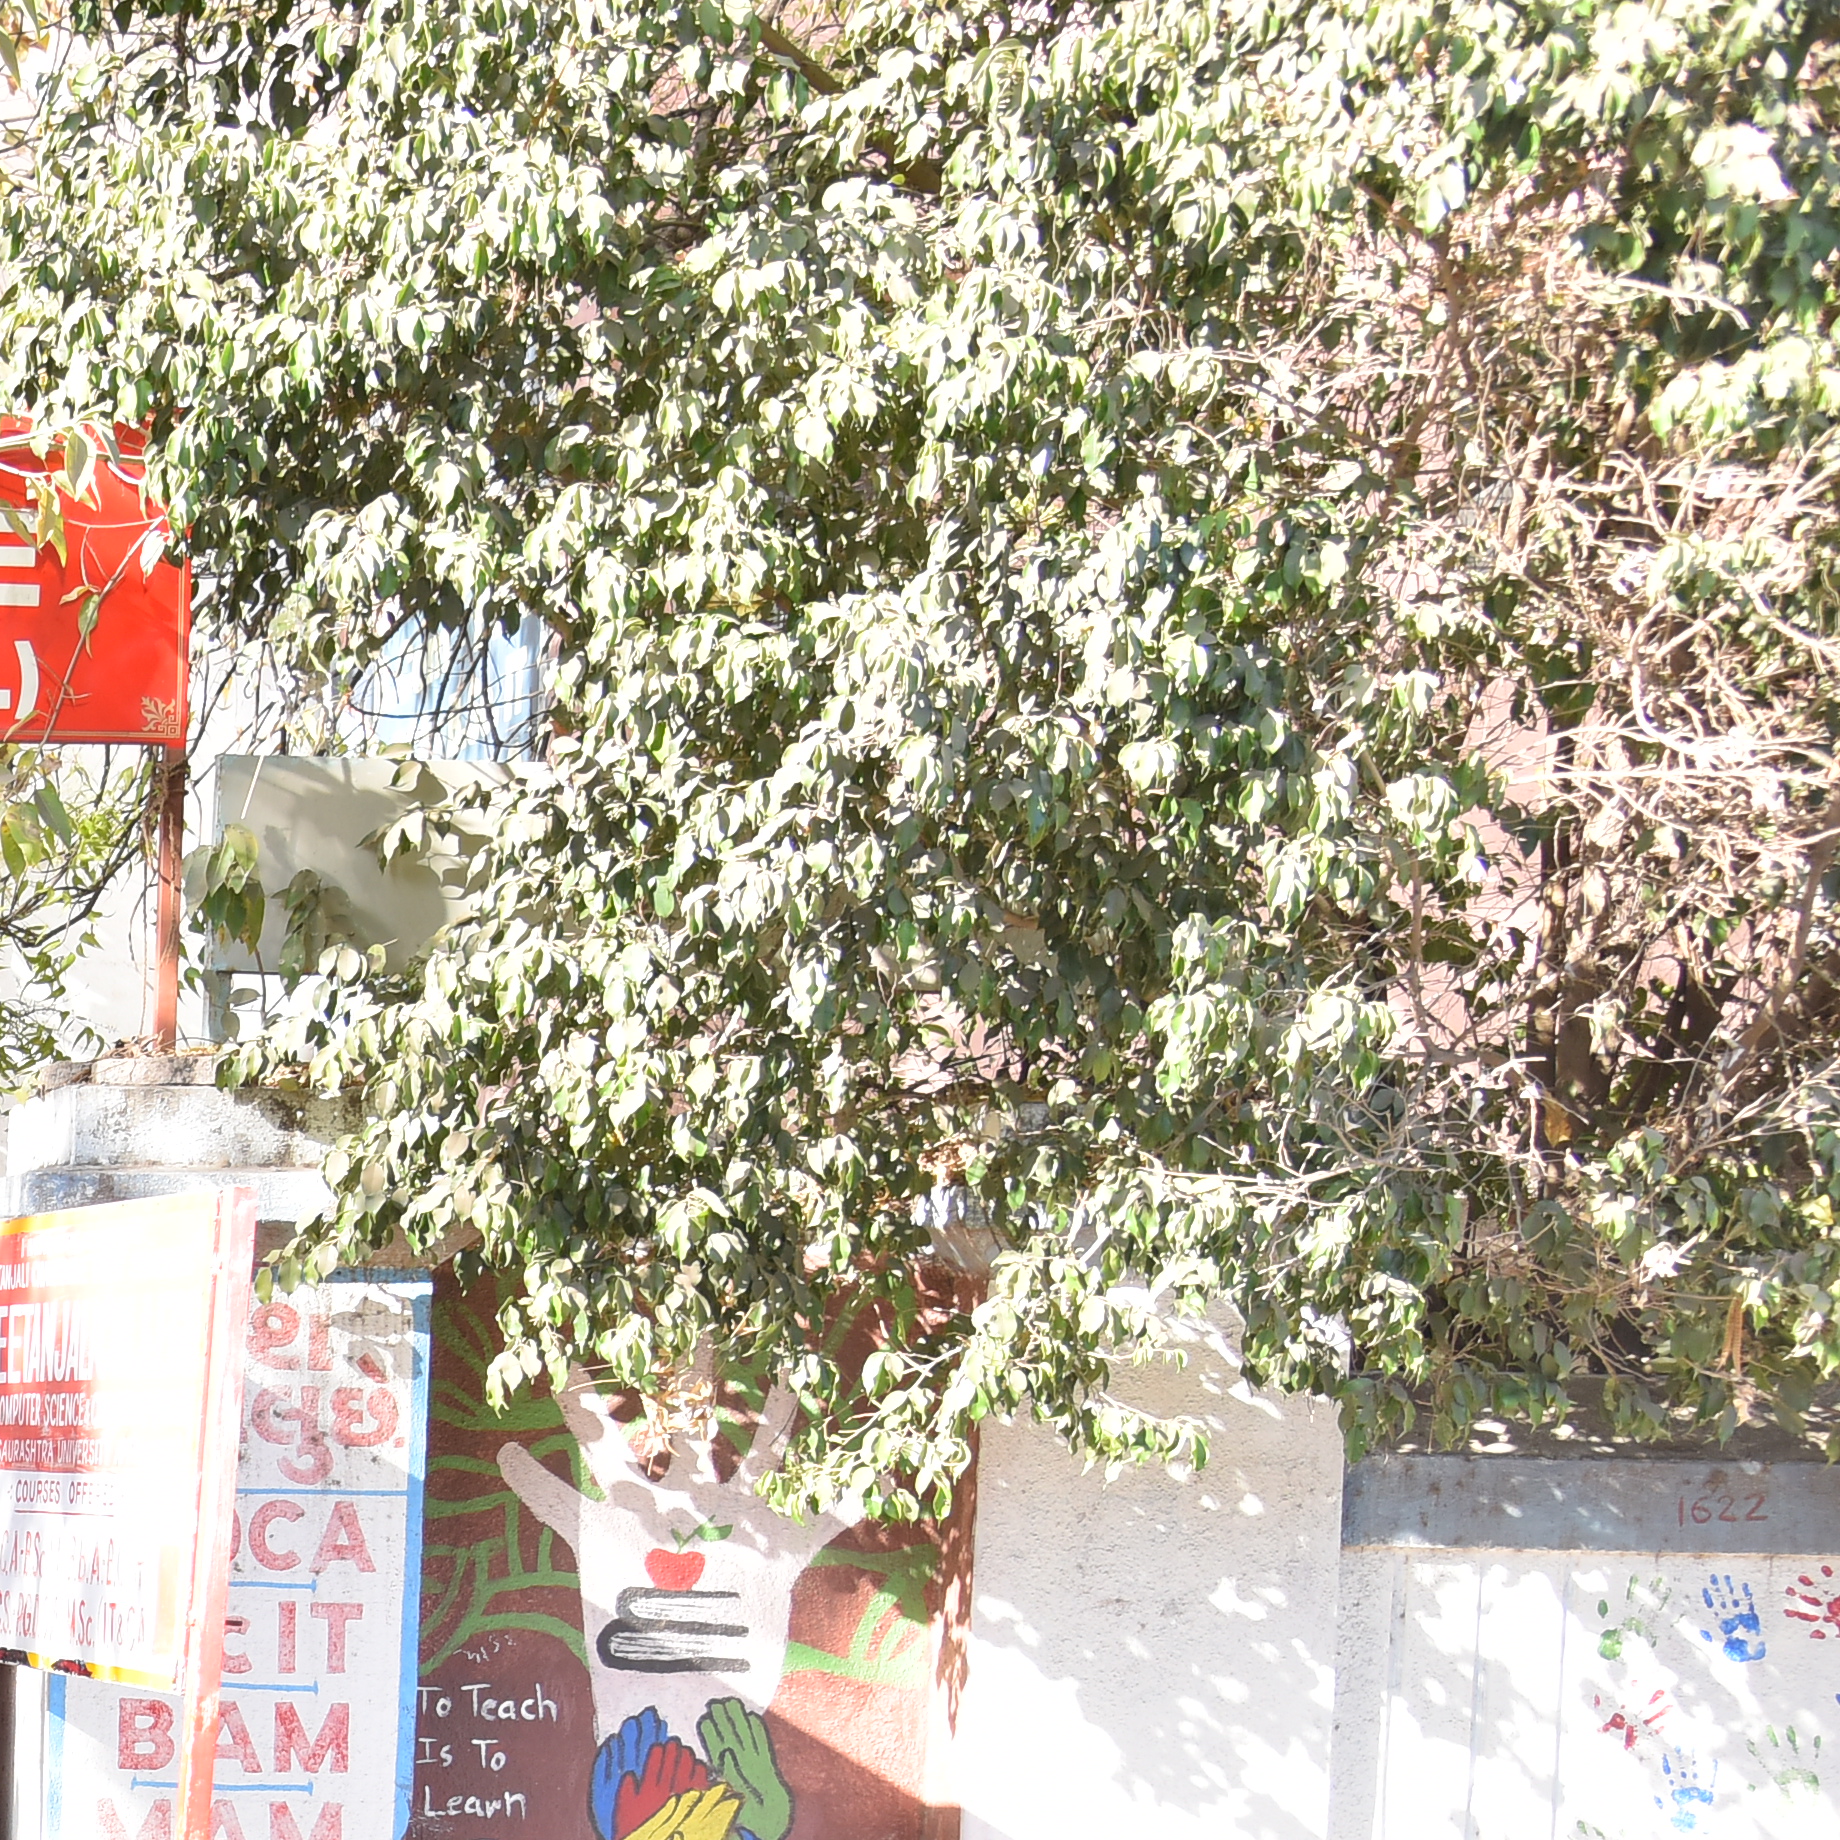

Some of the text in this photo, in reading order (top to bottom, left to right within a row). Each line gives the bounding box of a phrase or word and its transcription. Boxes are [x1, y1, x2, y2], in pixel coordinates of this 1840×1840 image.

[43, 1392, 85, 1428] SCIENCE
[56, 1437, 102, 1466] UNIVERSIT
[15, 1479, 61, 1504] COURSES
[1677, 1492, 1769, 1527] 1622
[417, 1682, 558, 1722] To Teach
[118, 1696, 350, 1775] BAM
[416, 1737, 507, 1772] Is To
[423, 1785, 527, 1820] Learn
